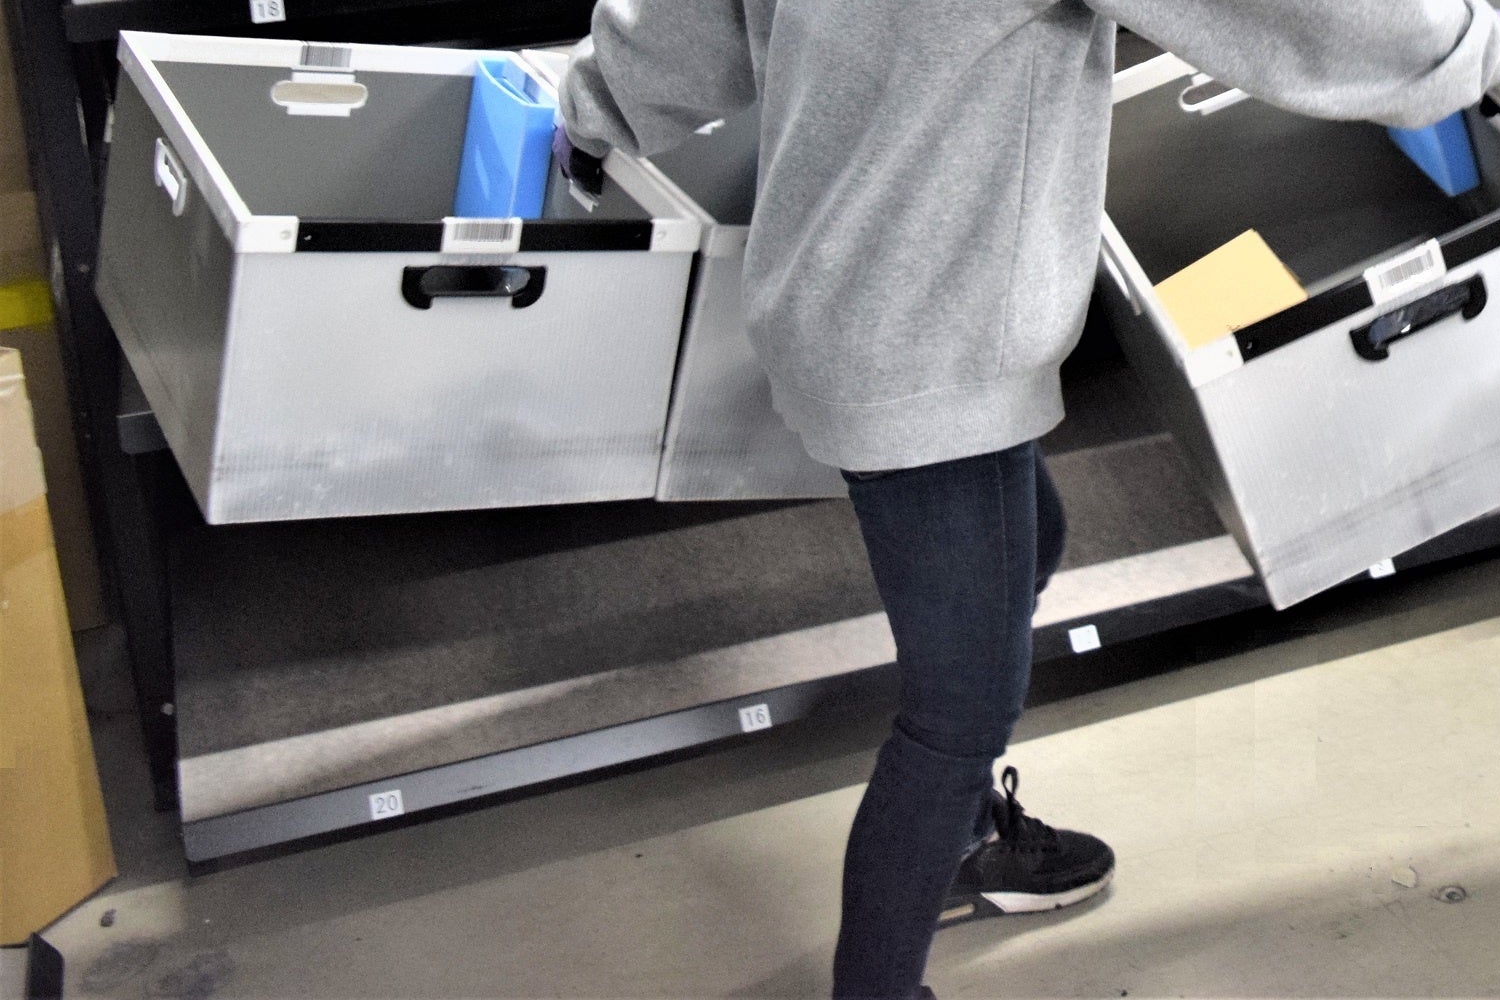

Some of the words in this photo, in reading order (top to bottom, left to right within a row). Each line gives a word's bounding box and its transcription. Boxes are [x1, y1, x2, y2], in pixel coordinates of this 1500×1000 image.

[258, 0, 280, 18] 18
[745, 708, 767, 727] 16
[374, 794, 399, 814] 20
